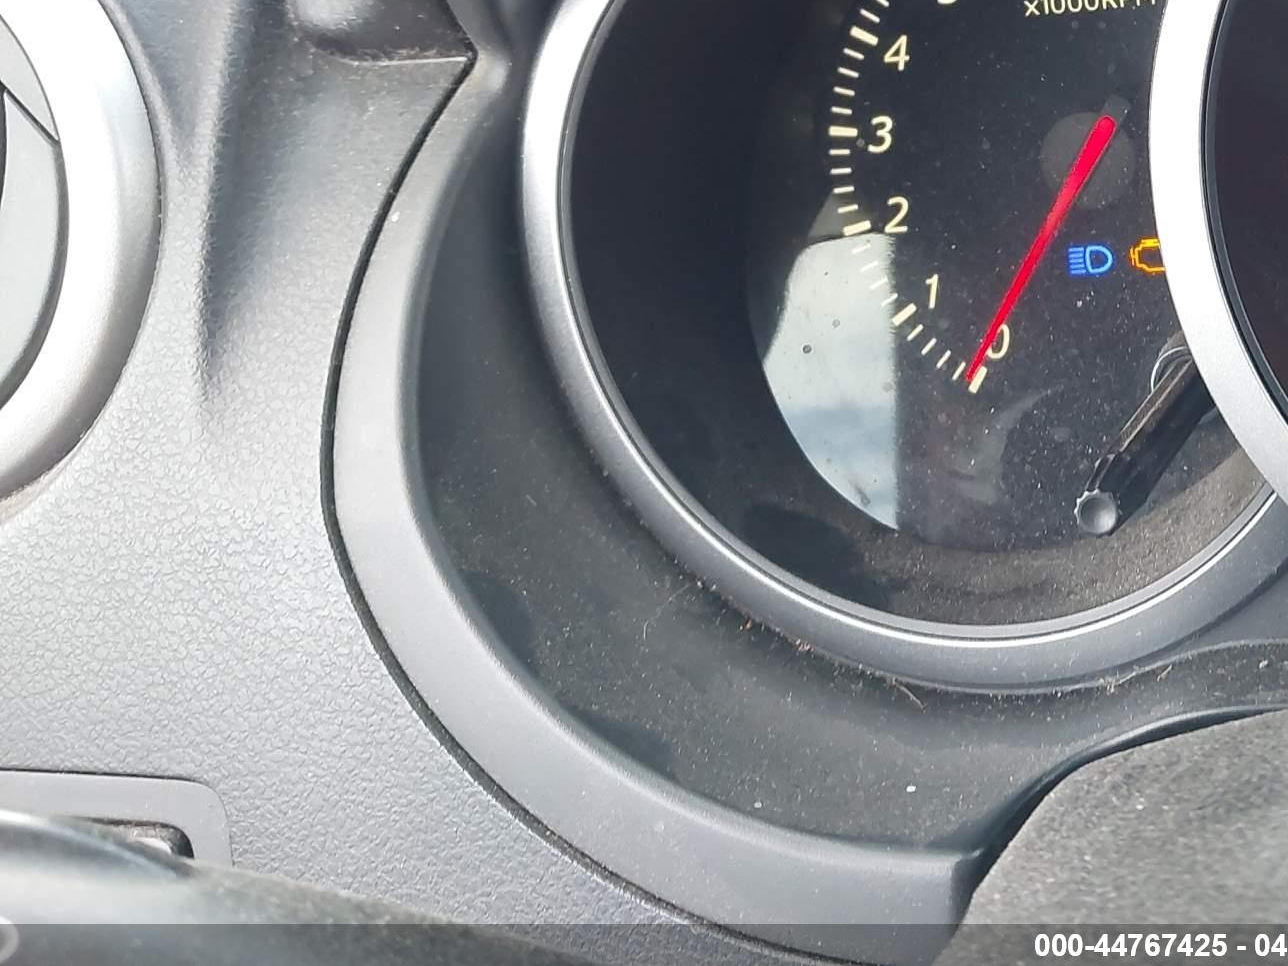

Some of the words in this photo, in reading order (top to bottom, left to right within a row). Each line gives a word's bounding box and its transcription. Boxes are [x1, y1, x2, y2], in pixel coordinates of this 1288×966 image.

[884, 35, 909, 70] 4
[868, 117, 893, 153] 3
[884, 198, 908, 233] 2
[925, 274, 940, 308] 1
[985, 324, 1011, 359] 0
